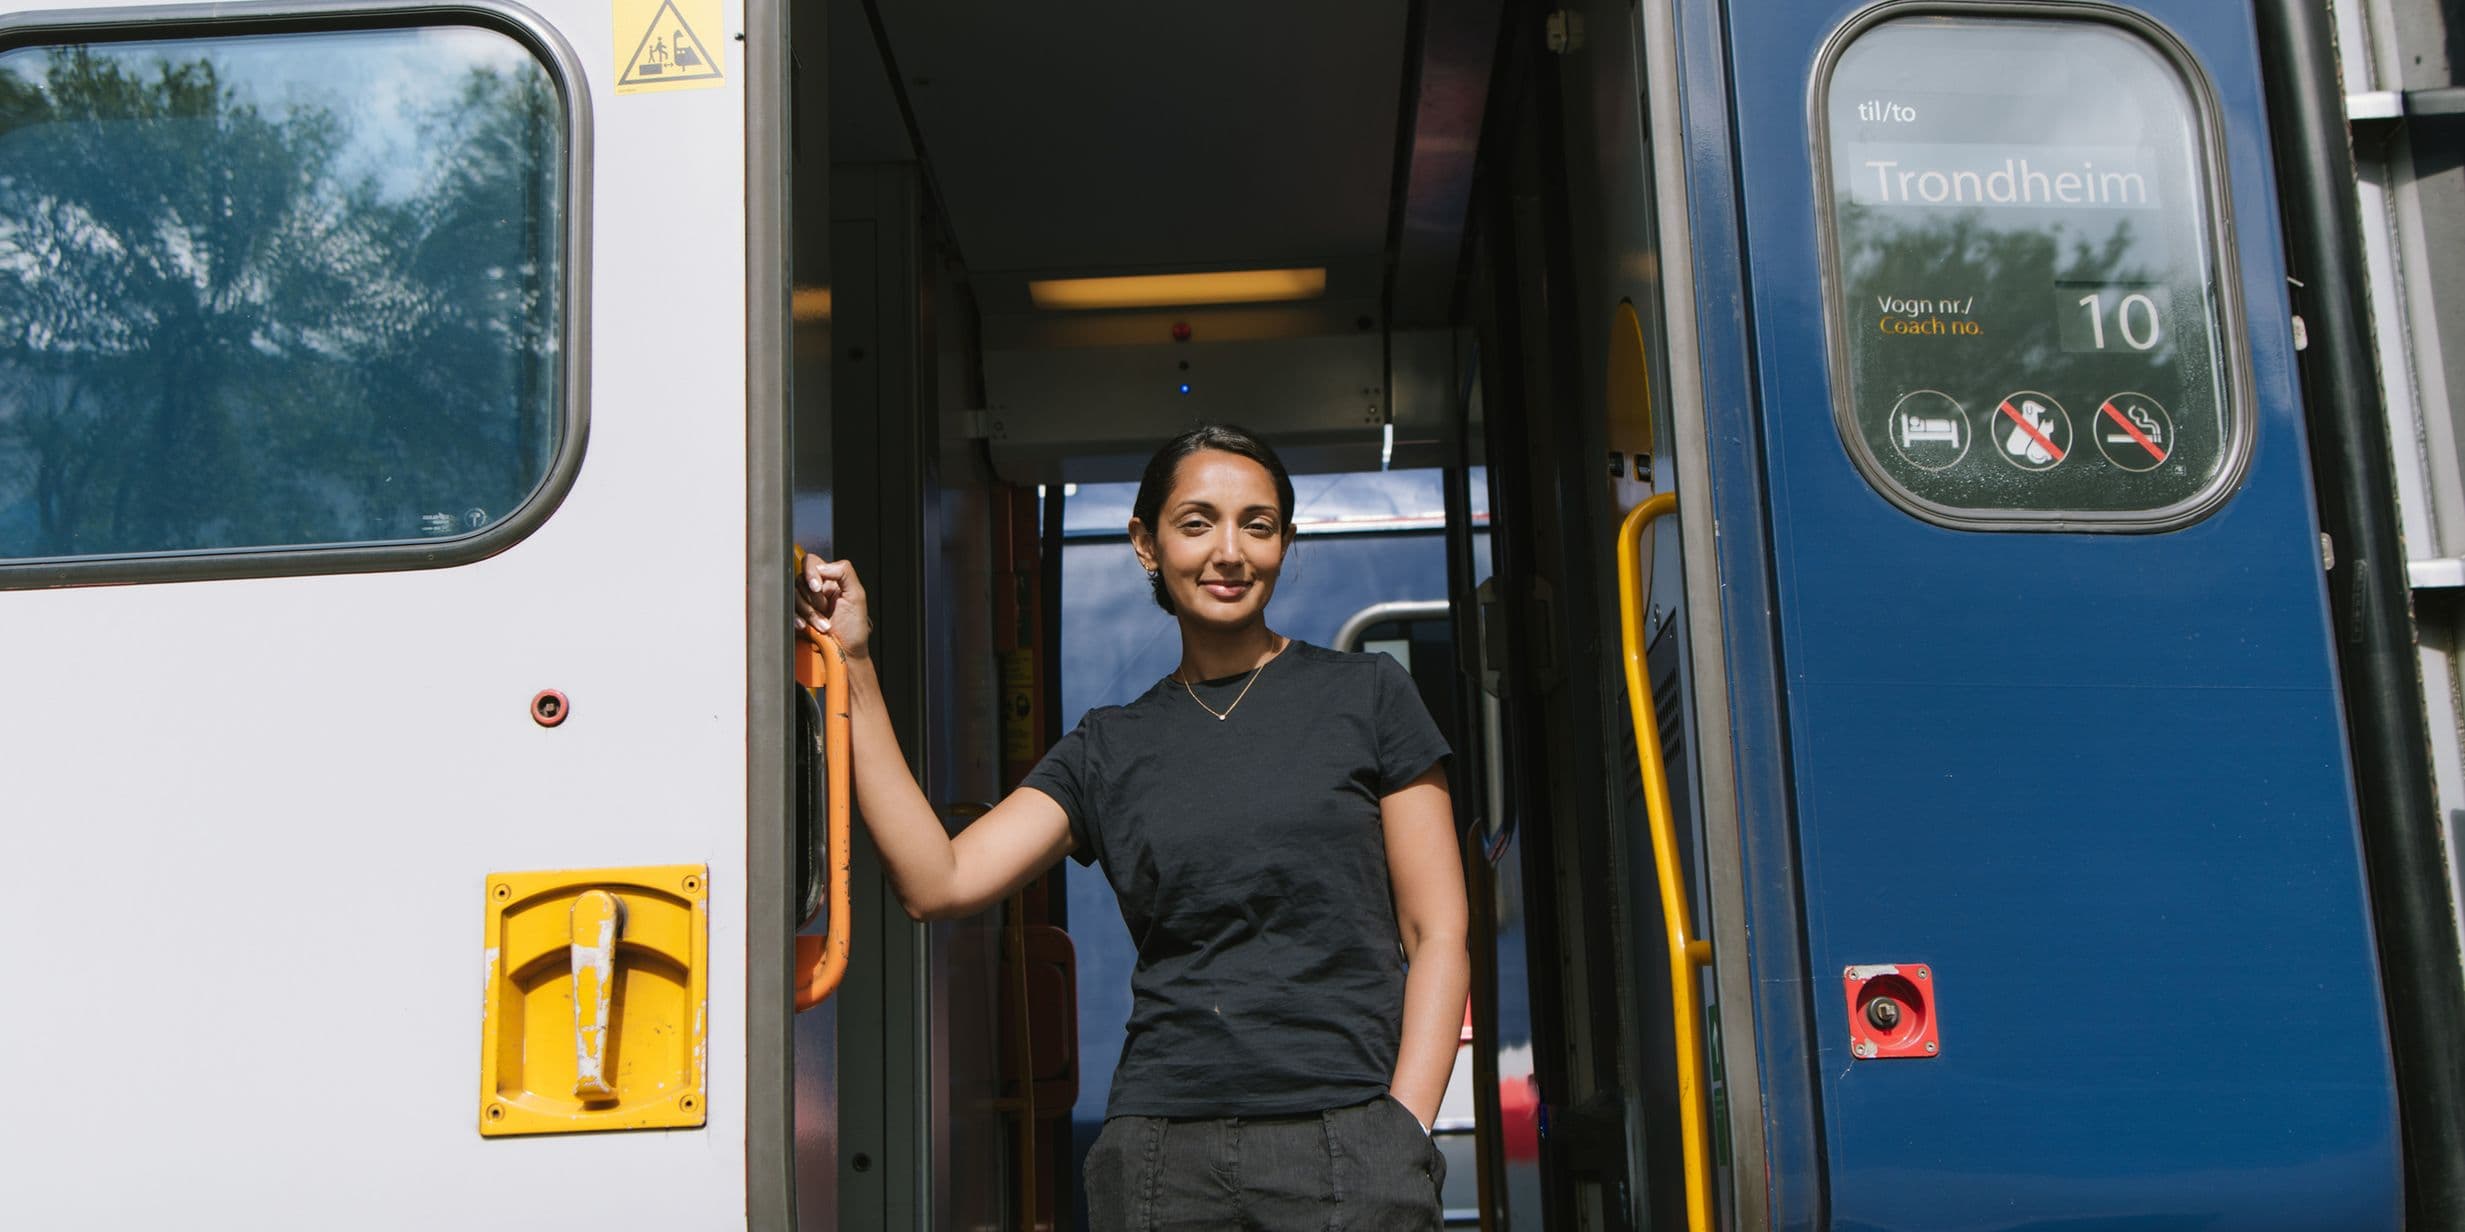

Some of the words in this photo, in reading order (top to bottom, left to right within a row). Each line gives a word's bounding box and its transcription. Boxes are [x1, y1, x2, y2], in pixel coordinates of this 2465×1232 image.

[1857, 100, 1916, 122] til/to
[1865, 159, 2147, 203] Trondheim
[1877, 296, 1933, 318] Vogn
[1939, 296, 1973, 314] nr./
[1880, 314, 1946, 335] Coach
[1951, 320, 1984, 335] no.
[2079, 293, 2160, 350] 10
